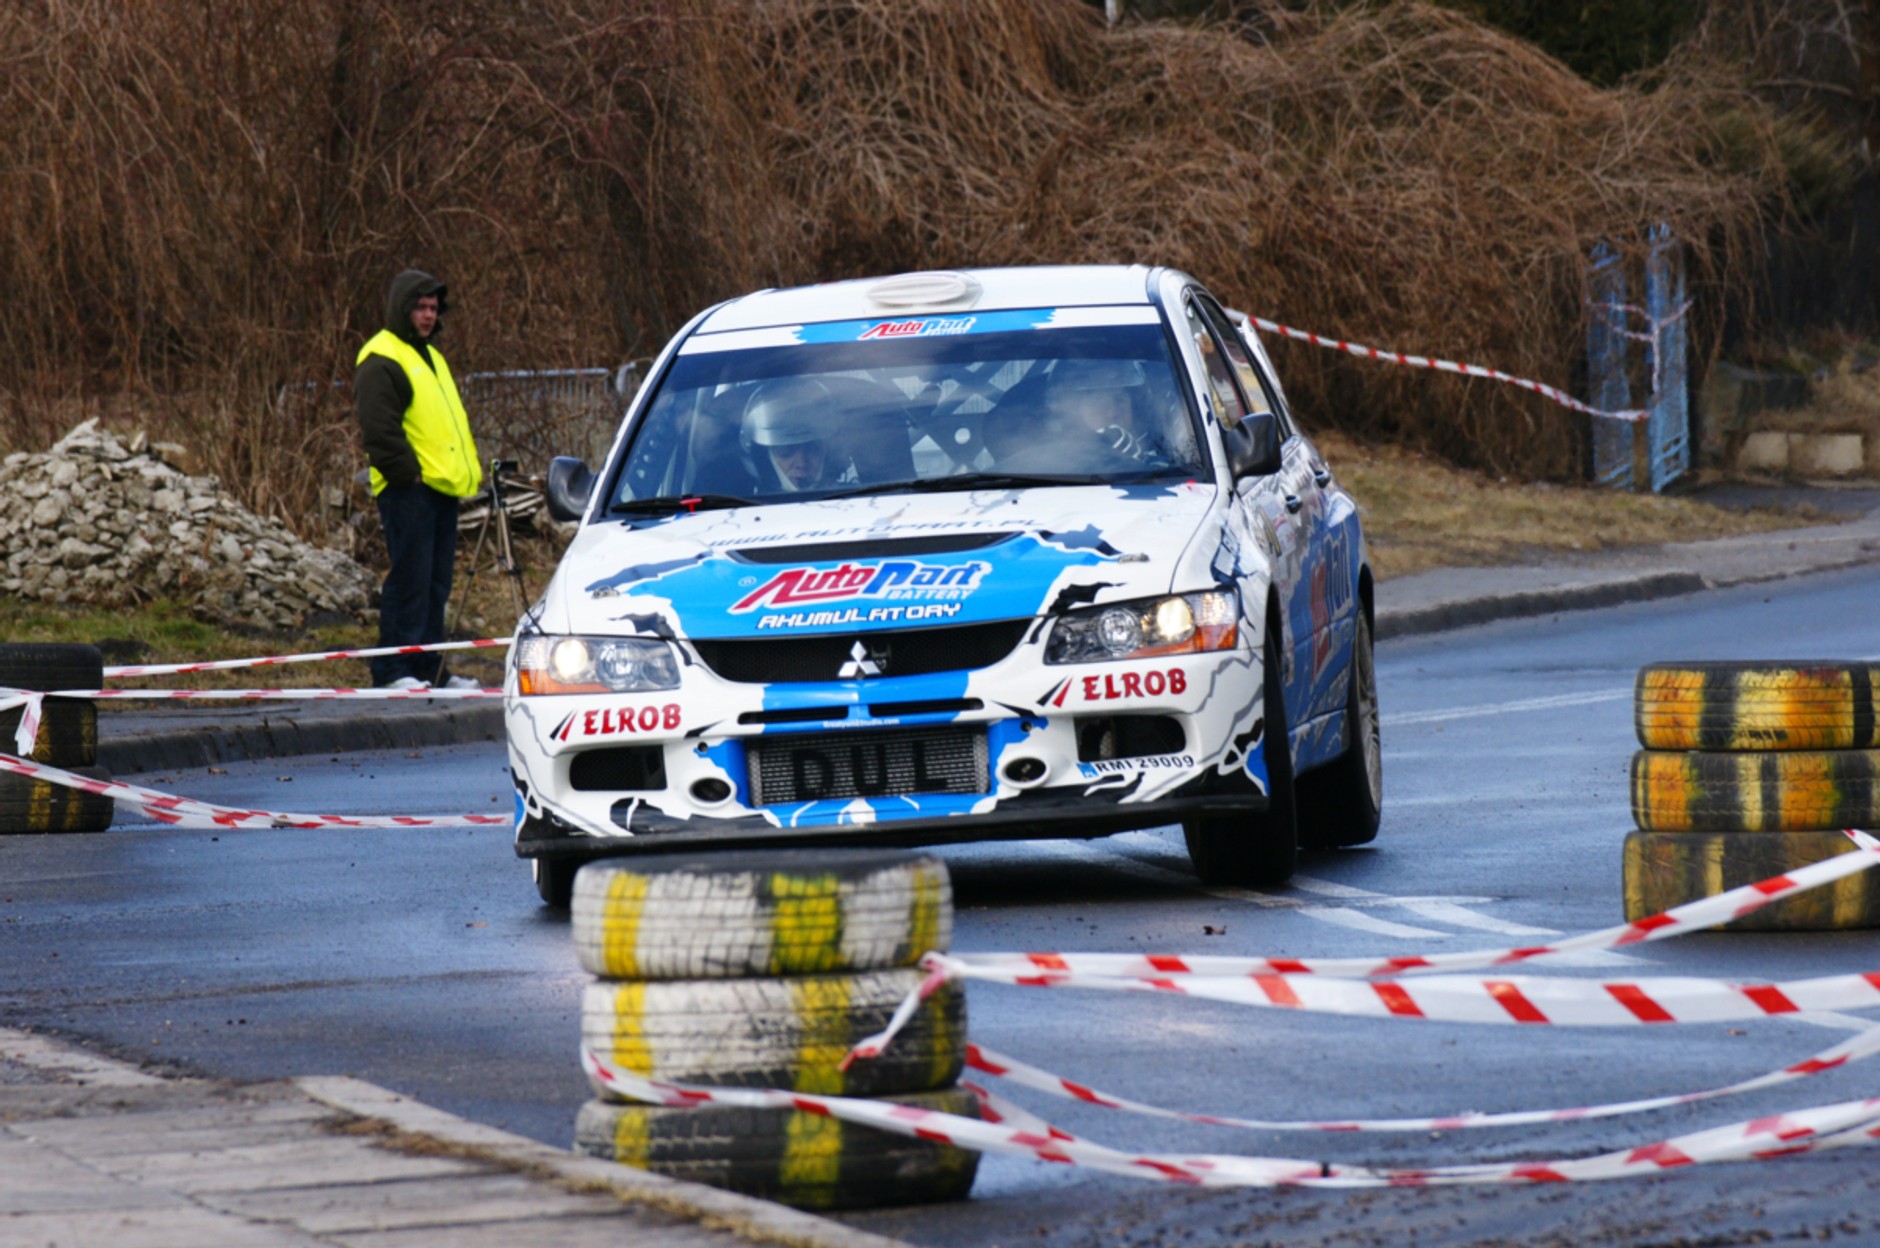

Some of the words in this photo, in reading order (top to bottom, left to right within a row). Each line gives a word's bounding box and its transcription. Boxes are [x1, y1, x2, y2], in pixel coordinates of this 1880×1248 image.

[727, 560, 993, 614] AutoPart
[887, 588, 975, 601] BATTERY
[755, 602, 963, 630] AKUMULATORY
[1082, 667, 1187, 701] ELROB
[583, 703, 682, 735] ELROB
[1095, 759, 1134, 773] RMI
[1135, 754, 1195, 769] 29009
